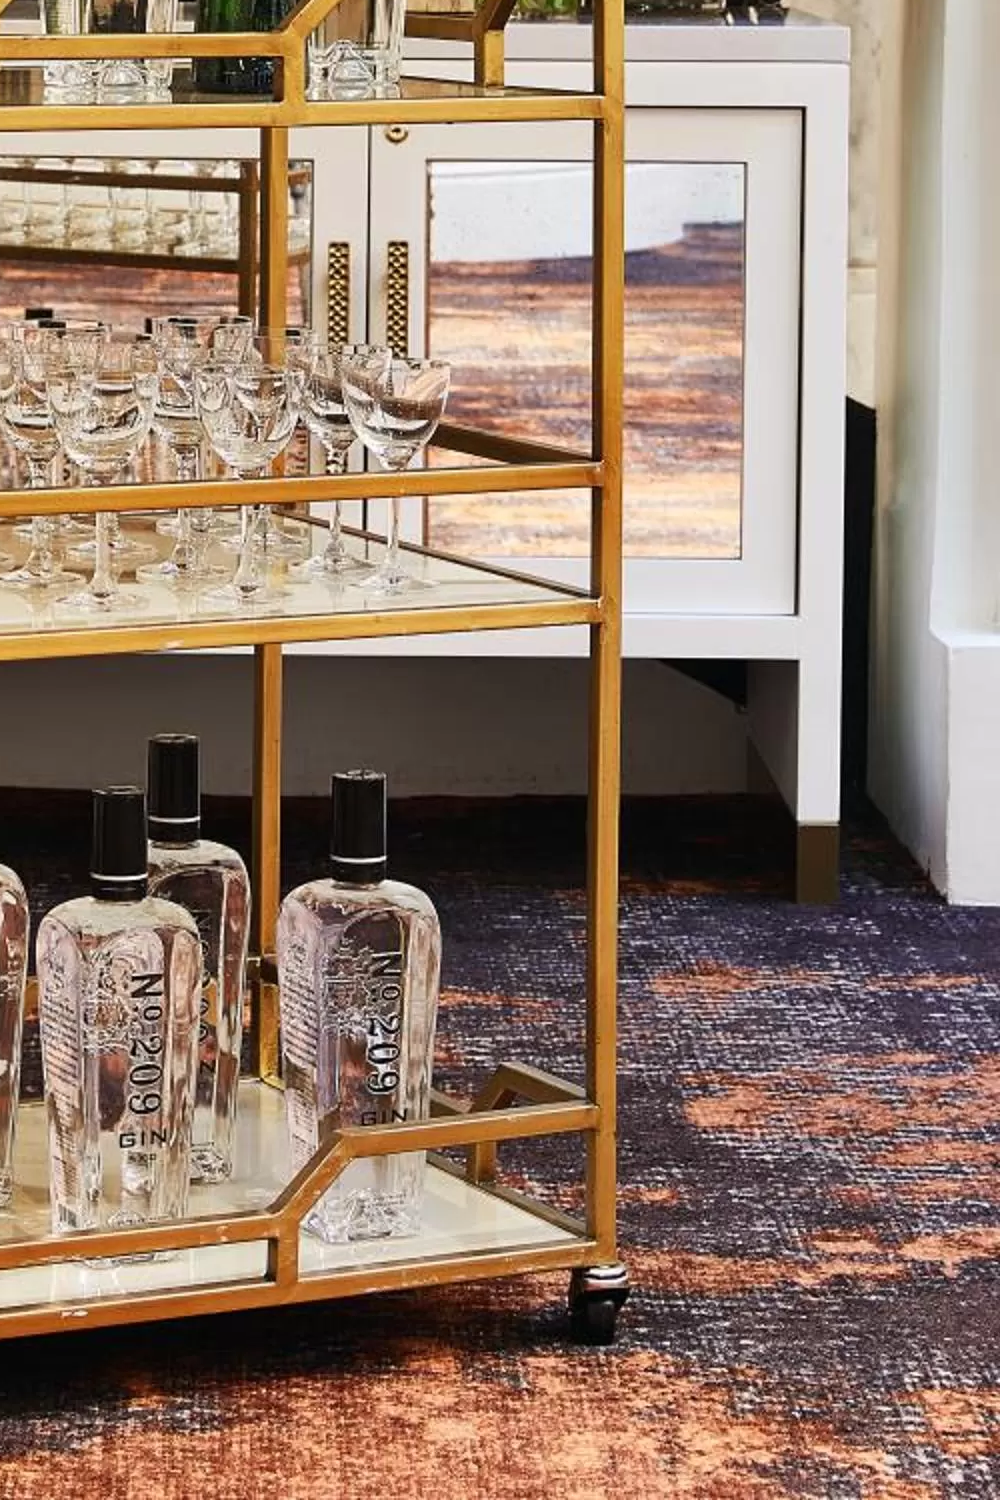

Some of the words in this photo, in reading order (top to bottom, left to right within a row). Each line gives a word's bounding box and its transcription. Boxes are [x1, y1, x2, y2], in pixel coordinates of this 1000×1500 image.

[128, 1036, 163, 1116] 209
[367, 1014, 400, 1095] 209
[119, 1128, 168, 1149] GIN
[361, 1108, 409, 1127] GIN
